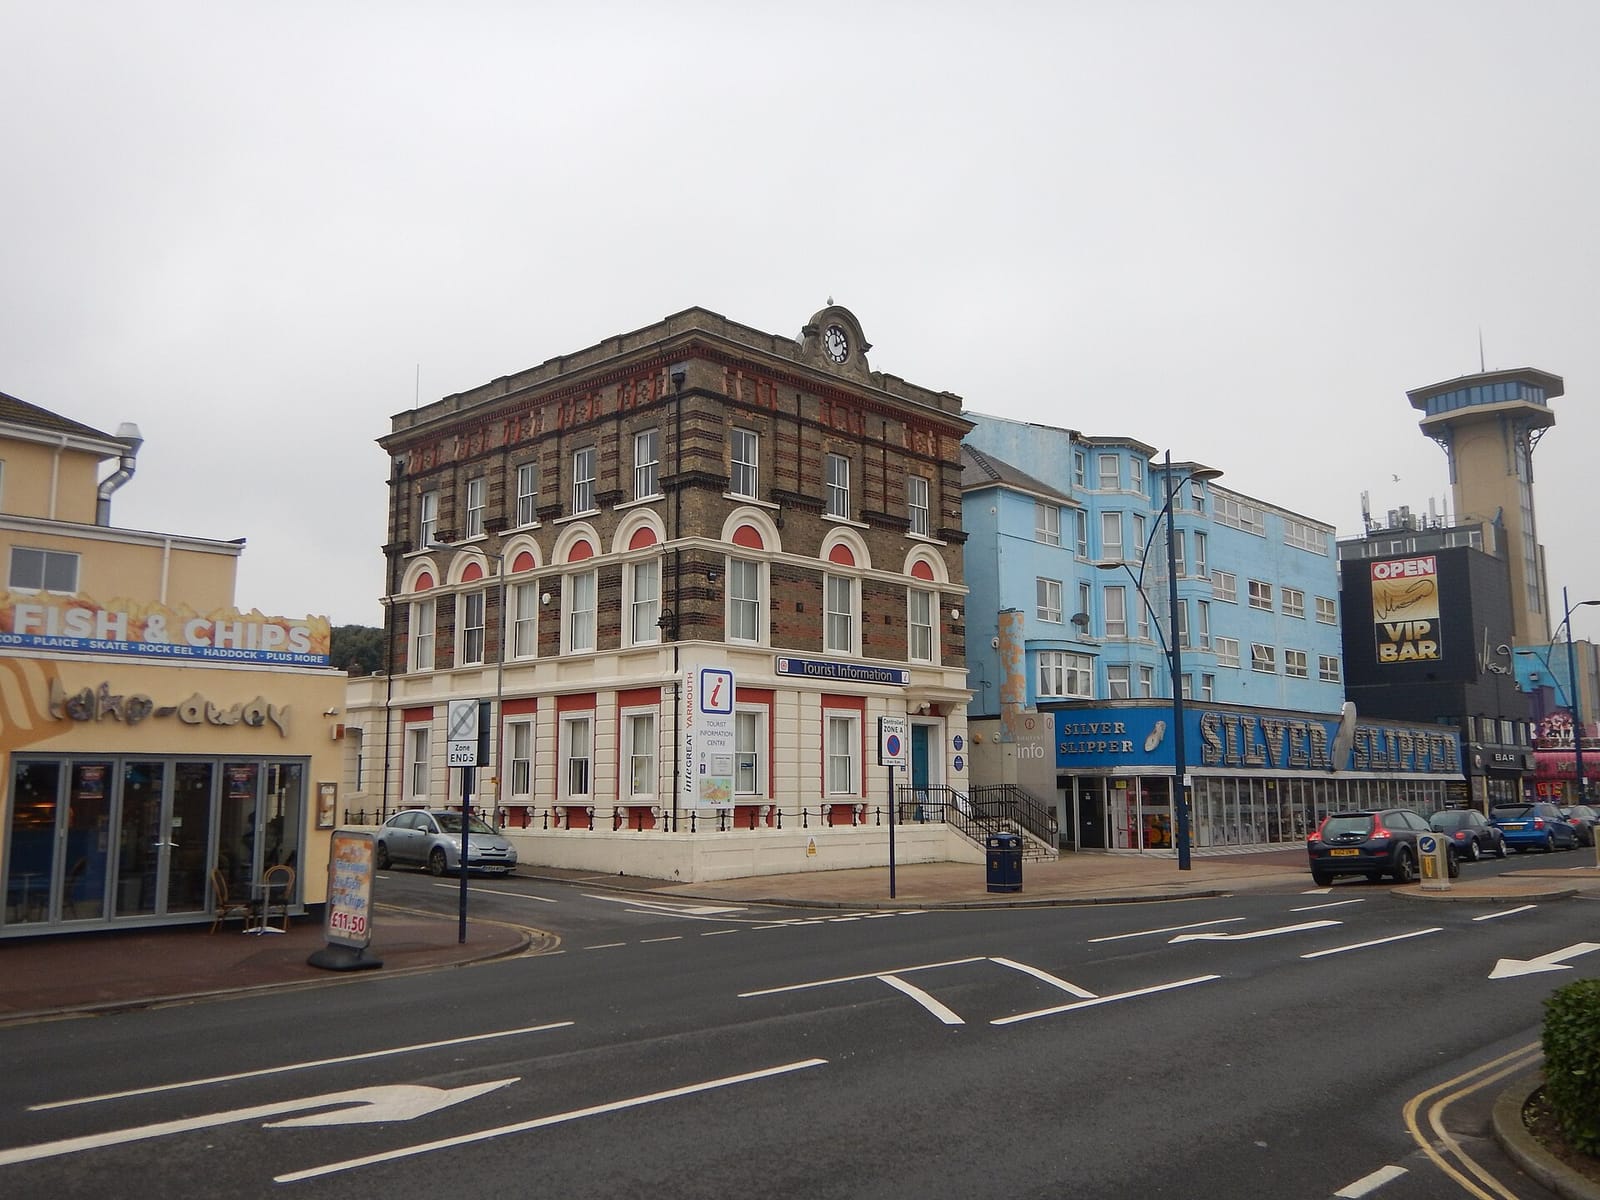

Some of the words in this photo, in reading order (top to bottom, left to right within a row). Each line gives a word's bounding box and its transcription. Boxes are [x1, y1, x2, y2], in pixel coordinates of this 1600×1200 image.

[1374, 559, 1434, 579] OPEN
[14, 603, 128, 641] FISH
[143, 614, 170, 644] &
[184, 618, 312, 654] CHIPS
[1384, 621, 1431, 642] VIP
[0, 634, 22, 644] OD
[33, 636, 79, 648] PLAICE
[89, 640, 129, 650] SKATE
[138, 644, 170, 653] ROCK
[174, 646, 195, 655] EEL
[203, 648, 257, 660] HADDOCK
[266, 653, 292, 662] PLUS
[294, 655, 324, 663] MORE
[1380, 639, 1438, 662] BAR
[802, 661, 836, 677] Tourist
[838, 665, 893, 681] Information
[686, 672, 694, 729] YARMOUTH
[706, 720, 727, 728] TOURIST
[883, 725, 898, 734] ZONE
[1064, 722, 1126, 735] SILVER
[455, 744, 471, 752] Zone
[1017, 742, 1044, 759] info
[1060, 740, 1134, 753] SLIPPER
[1201, 712, 1332, 769] SILVER
[1353, 725, 1460, 771] SLIPPER
[450, 753, 474, 763] ENDS
[1495, 753, 1515, 761] BAR
[331, 912, 366, 933] £11.50
